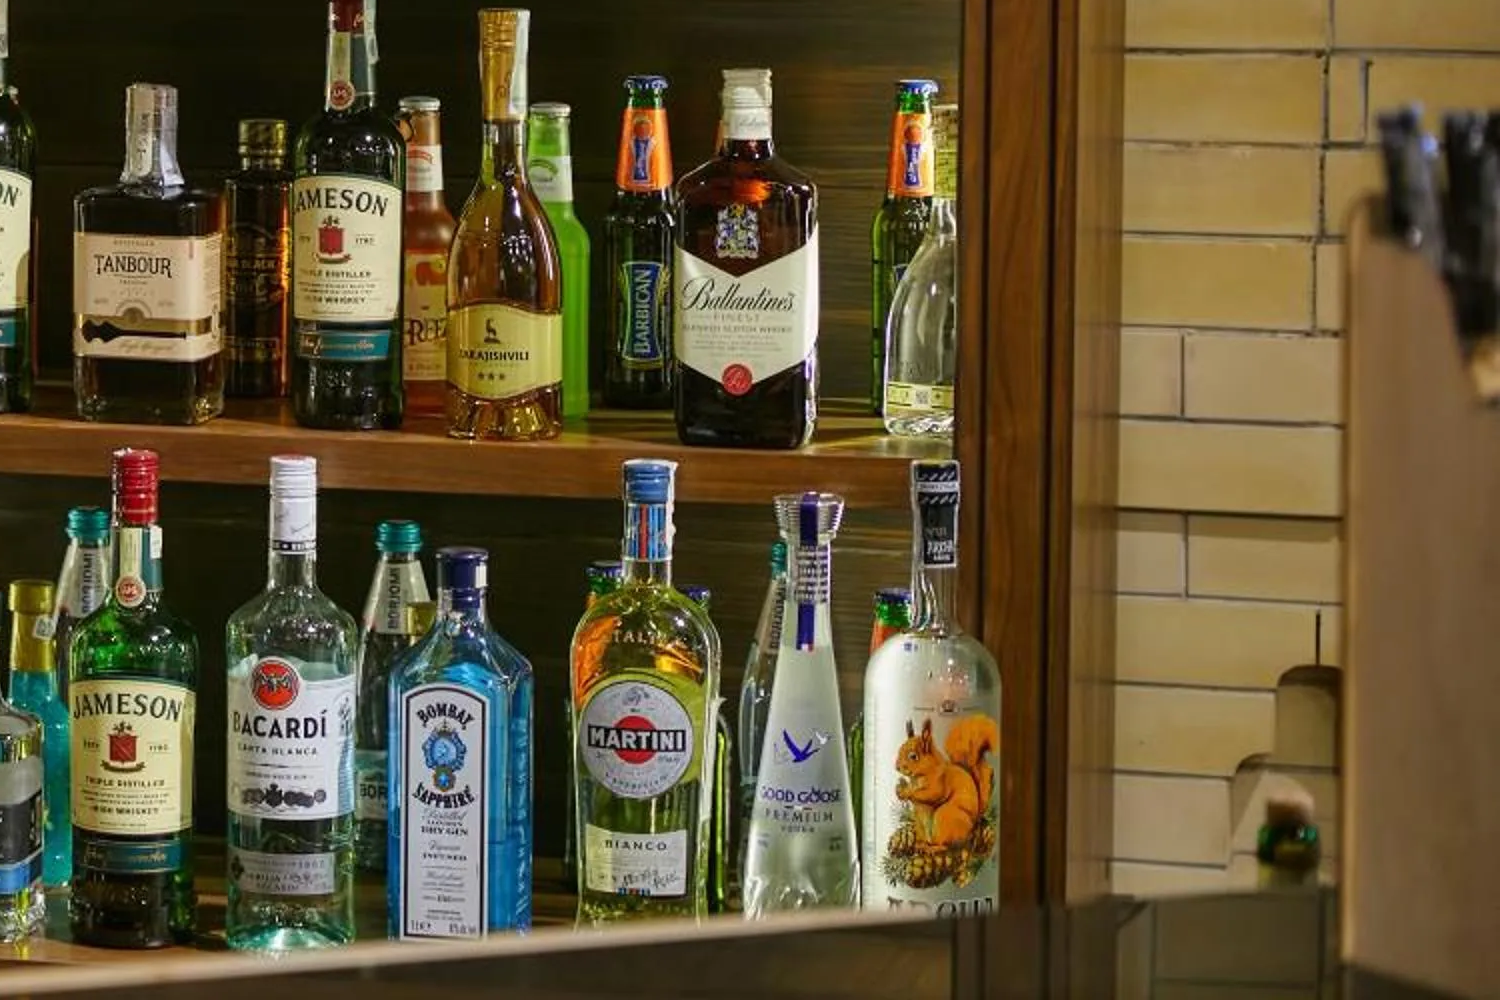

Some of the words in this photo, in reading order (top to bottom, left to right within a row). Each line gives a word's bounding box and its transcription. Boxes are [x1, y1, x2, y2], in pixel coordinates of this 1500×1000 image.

[294, 187, 389, 217] AMESON
[94, 254, 172, 278] TANBOUR
[682, 276, 795, 312] Ballantine's
[634, 269, 652, 354] BARBICAN
[73, 693, 182, 722] JAMESON
[416, 702, 475, 730] BOMBAY
[233, 710, 327, 739] BACARDÍ
[589, 727, 684, 750] MARTINI
[412, 781, 475, 808] SAPPHIRE
[765, 807, 833, 823] PREMIUM
[605, 839, 667, 851] BIANCO
